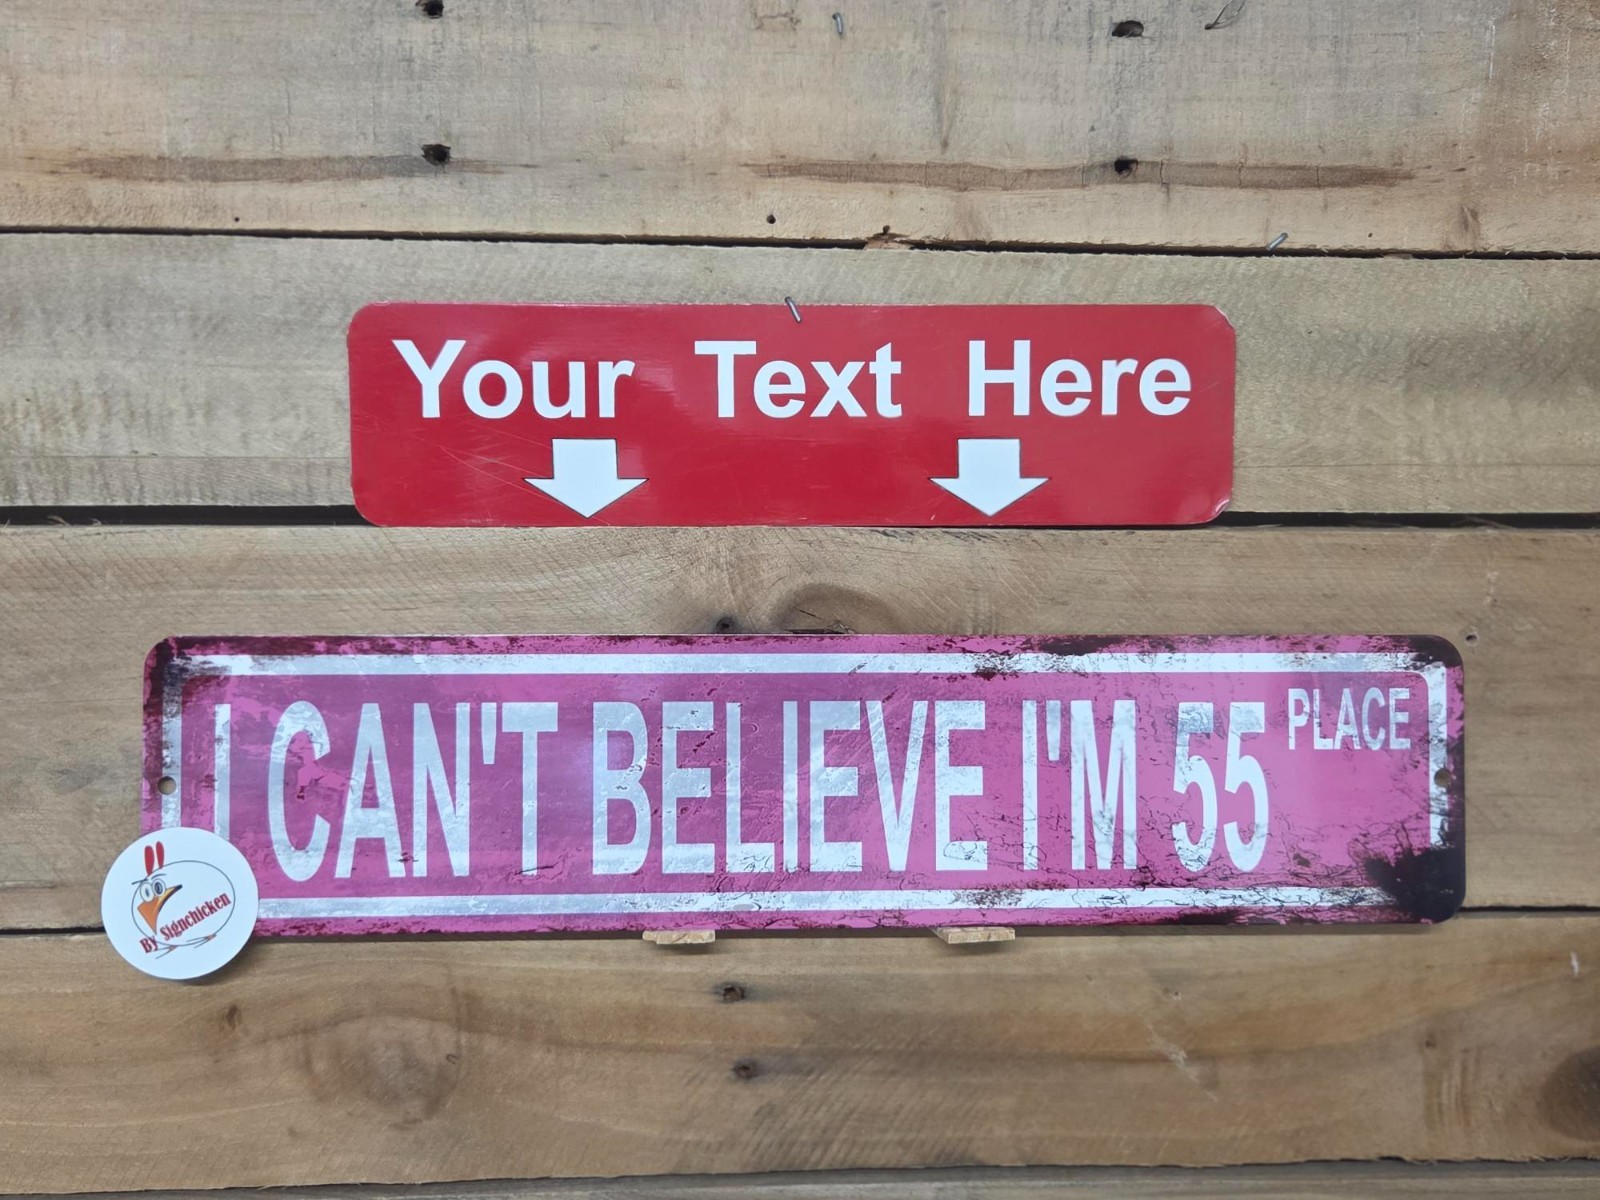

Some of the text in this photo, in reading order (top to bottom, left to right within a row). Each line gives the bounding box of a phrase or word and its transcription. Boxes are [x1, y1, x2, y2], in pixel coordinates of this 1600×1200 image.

[392, 339, 1192, 420] Your Text Here
[1287, 686, 1411, 750] PLACE
[213, 699, 1268, 882] I CAN'T BELIEVE I'M 55
[139, 892, 232, 954] By Signchicken
